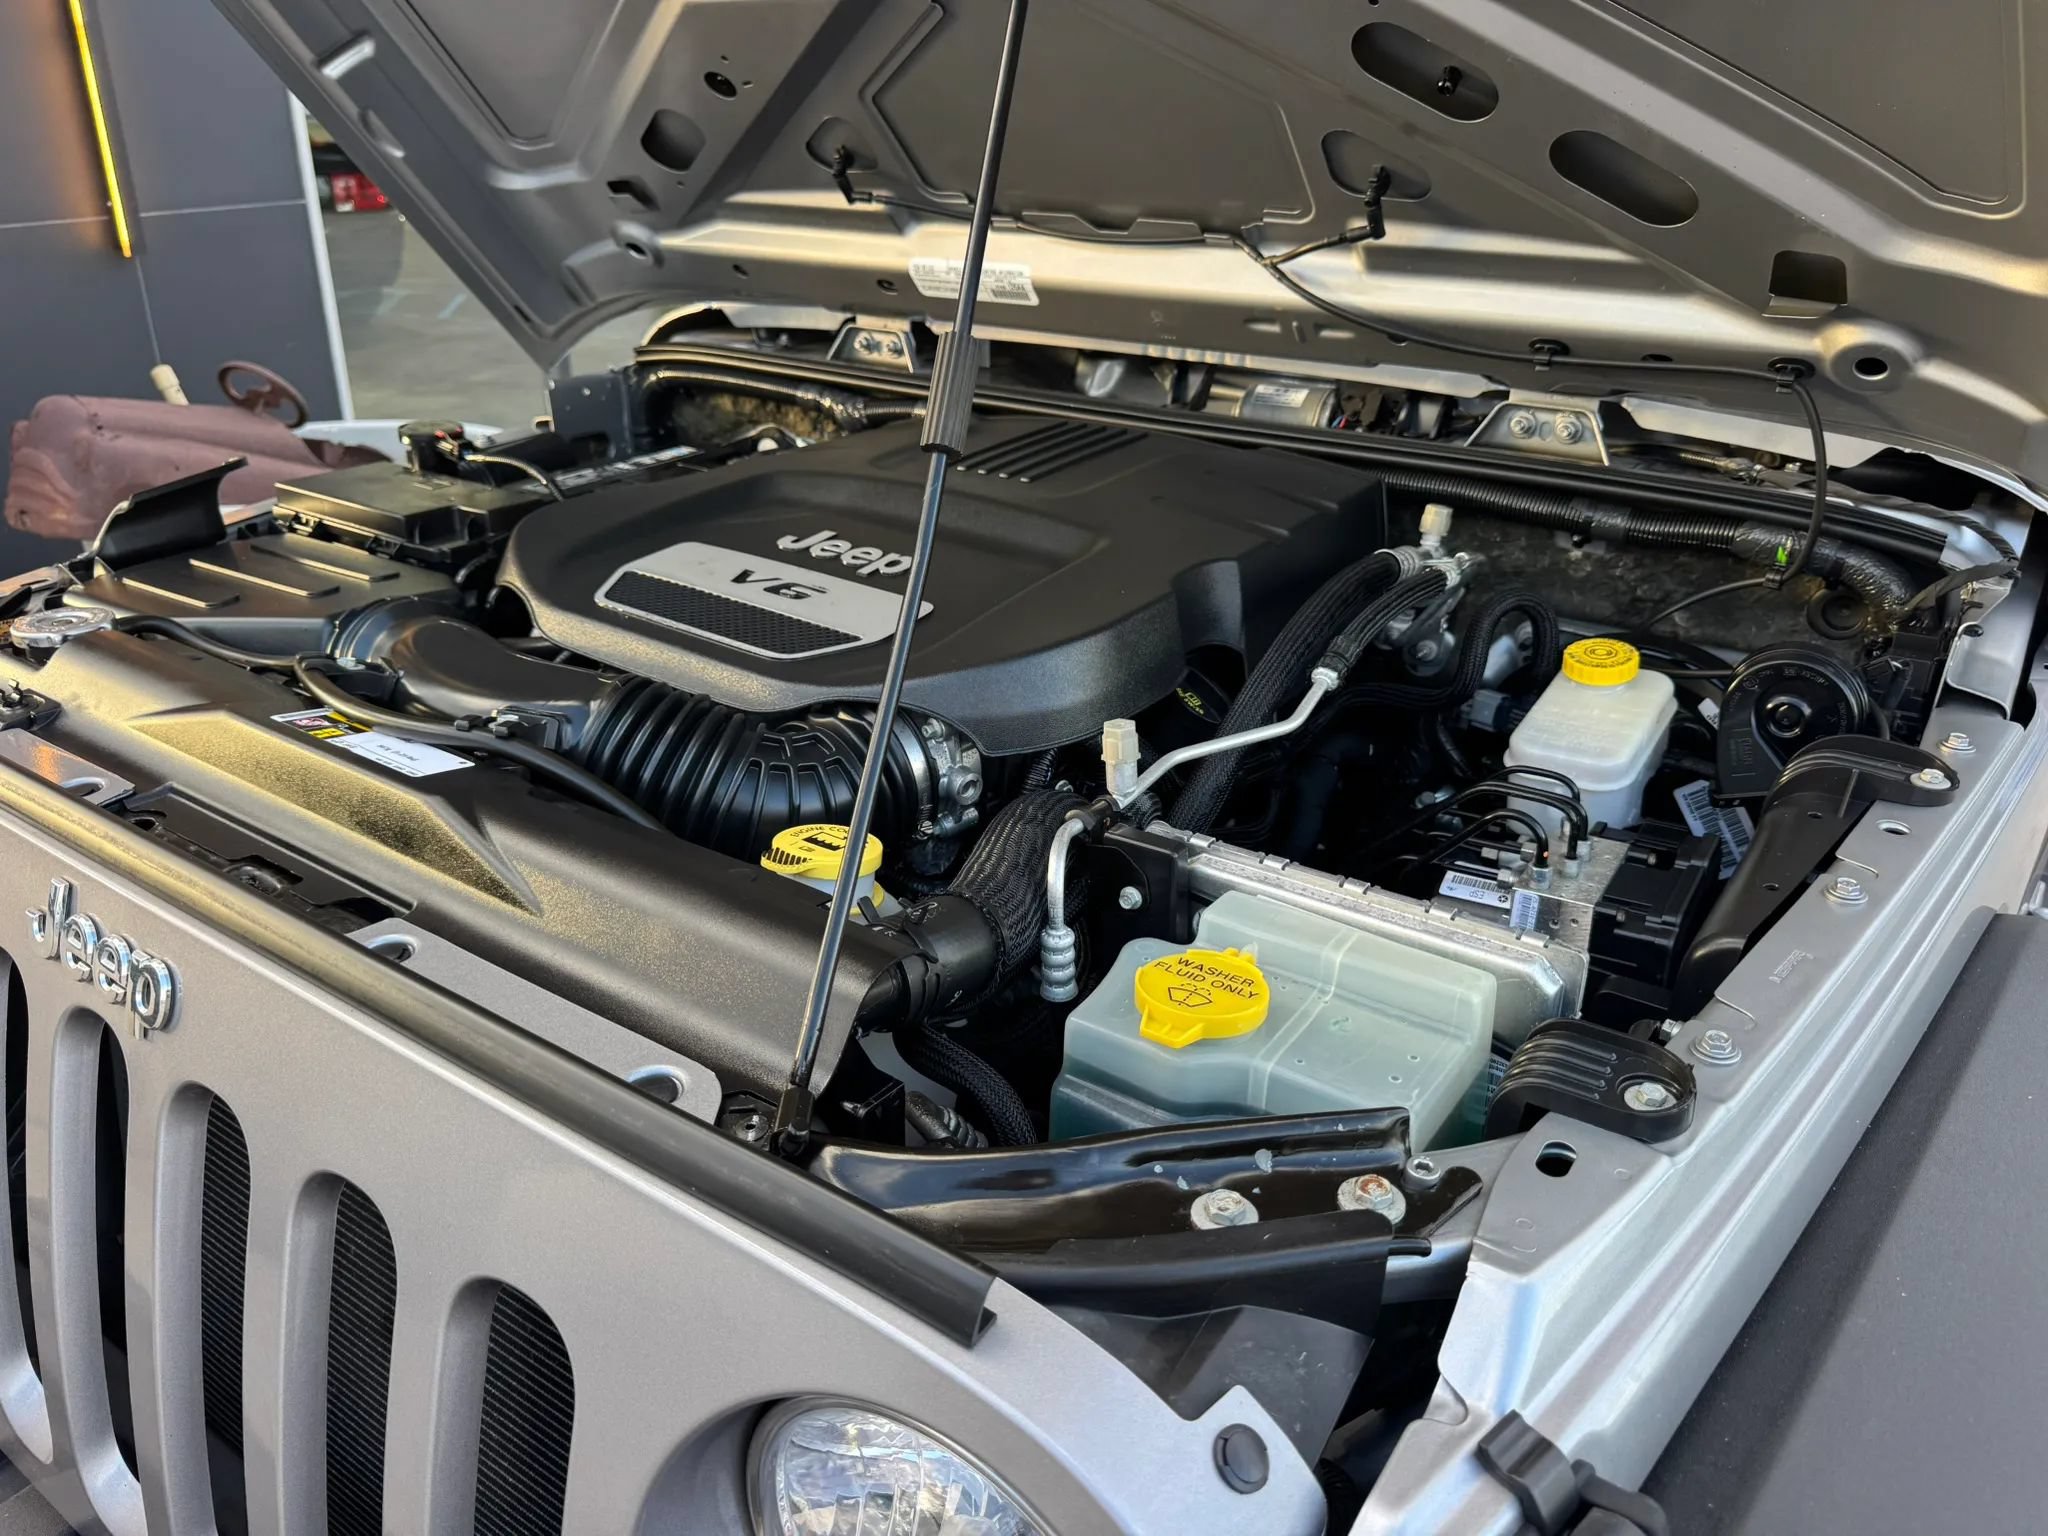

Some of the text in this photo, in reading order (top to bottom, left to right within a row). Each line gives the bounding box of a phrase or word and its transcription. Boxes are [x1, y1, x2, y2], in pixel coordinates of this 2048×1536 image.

[776, 530, 913, 577] Jeep
[731, 569, 828, 599] V6
[790, 825, 825, 838] ENGINE
[1469, 890, 1486, 900] ESP
[25, 877, 173, 1041] Jeep
[1178, 957, 1255, 988] WASHER
[1154, 961, 1259, 1000] FLUID ONLY
